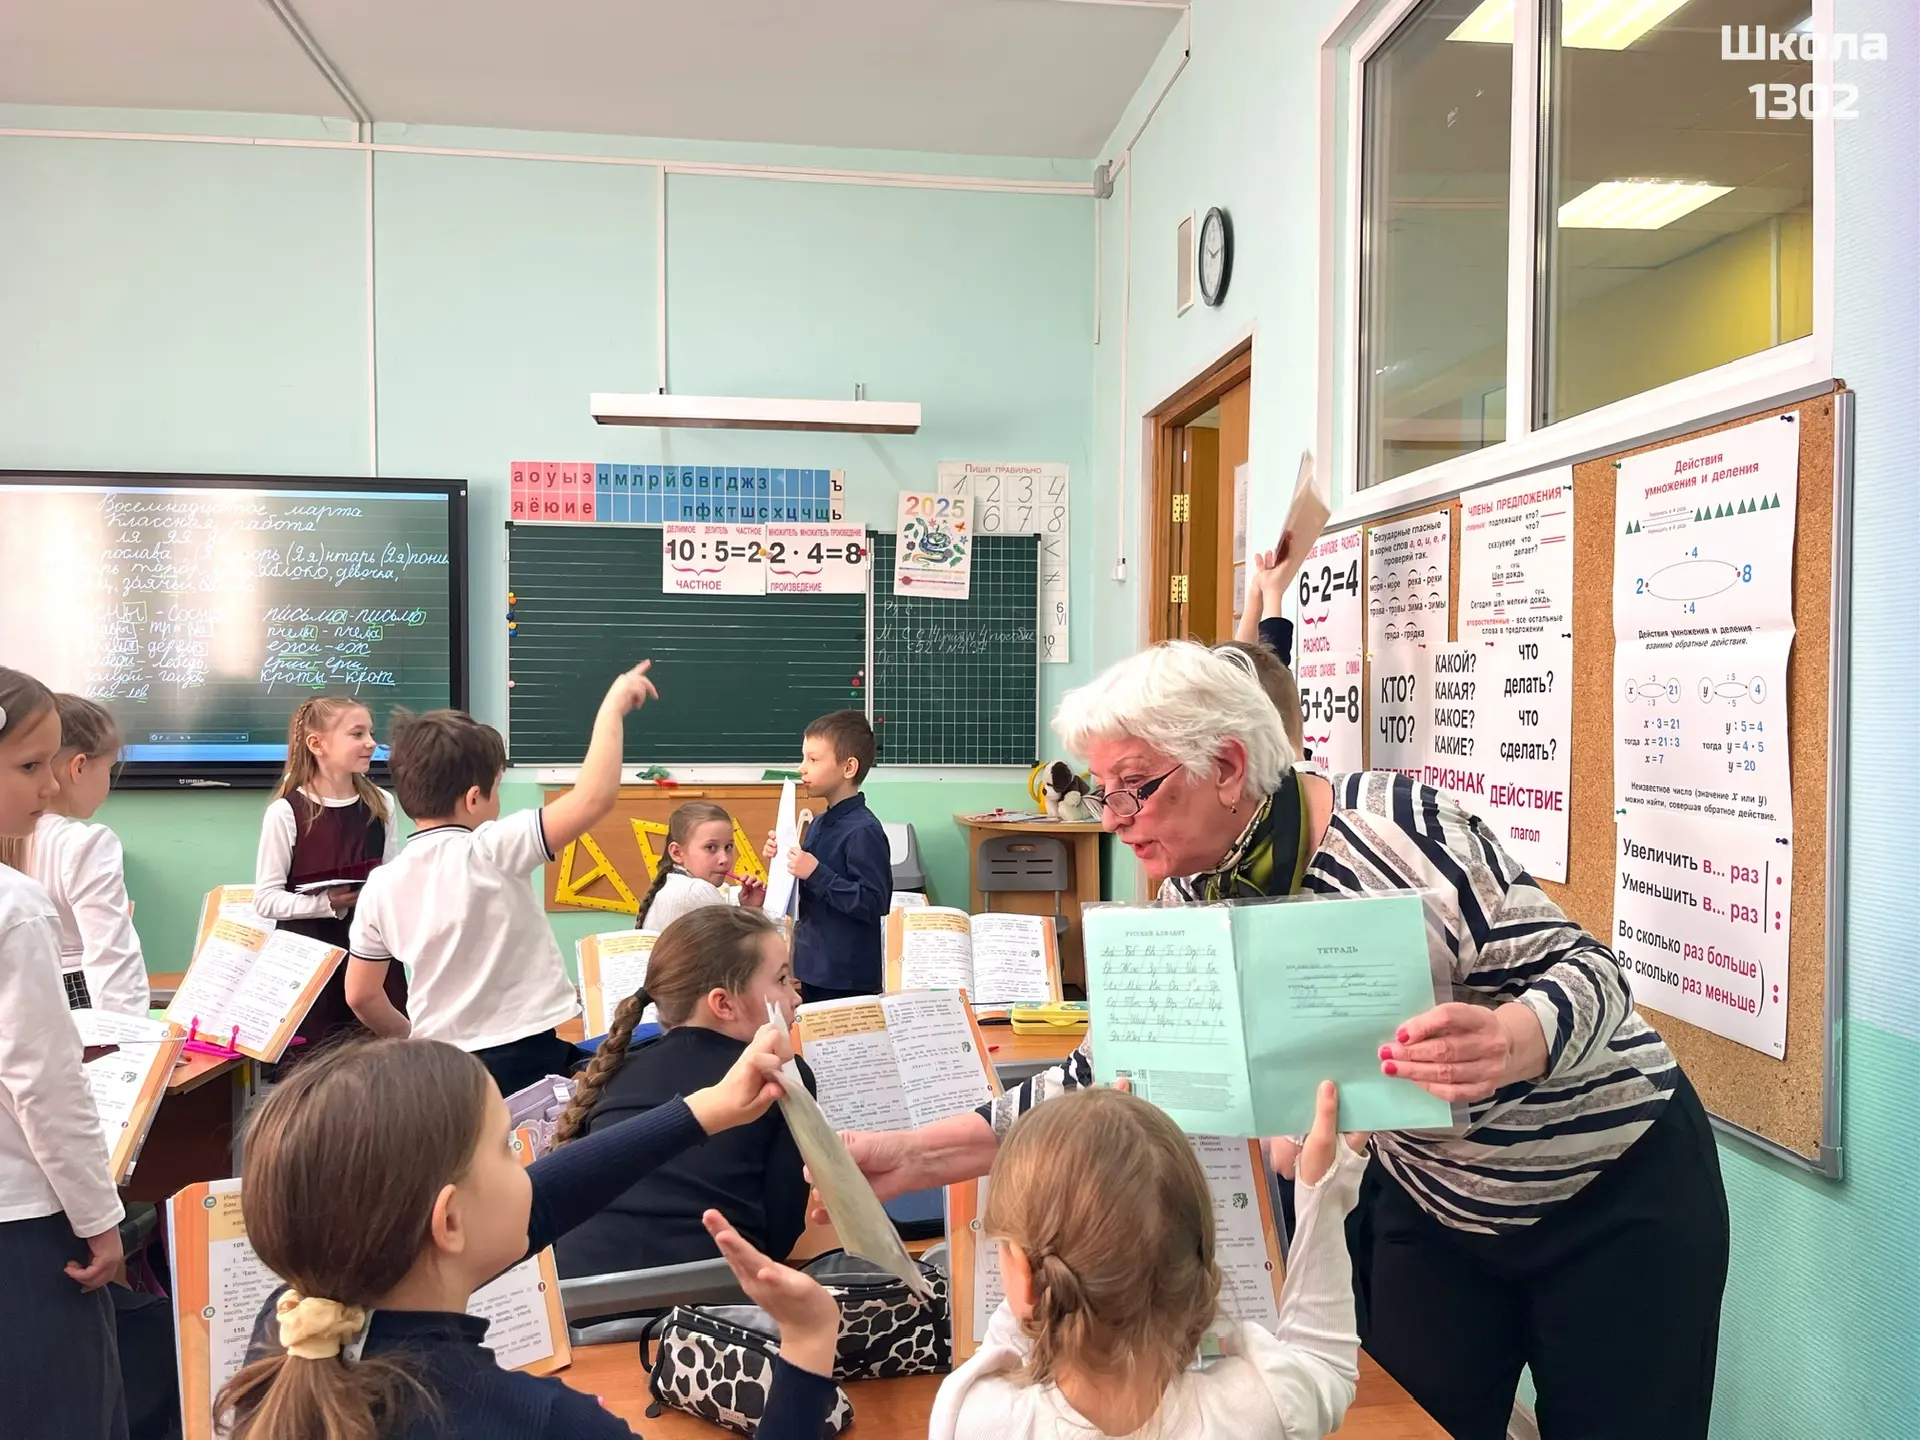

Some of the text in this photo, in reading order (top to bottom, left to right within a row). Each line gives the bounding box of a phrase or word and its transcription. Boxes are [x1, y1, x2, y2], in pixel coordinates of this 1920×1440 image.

[1674, 453, 1723, 475] Действия
[953, 475, 1065, 503] 1 2 3 4
[1645, 462, 1759, 499] умножения и деления
[904, 496, 965, 518] 2025
[1468, 486, 1562, 517] ЧЛЕНЫ ПРЕДЛОЖЕНИЯ
[105, 512, 214, 530] Классная
[285, 504, 363, 523] марта
[983, 506, 1065, 532] 6 7 8
[1525, 509, 1539, 521] кто?
[666, 525, 762, 535] ДЕЛИМОЕ ДЕЛИТЕЛЬ ЧАСТНОЕ
[768, 529, 862, 537] МНОЖИТЕЛЬ МНОЖИТЕЛЬ ПРОИЗВЕДЕНИЕ
[1374, 521, 1441, 542] Безударные гласные
[1525, 521, 1540, 530] что?
[1393, 541, 1408, 553] слов
[1514, 545, 1538, 557] делает?
[1384, 552, 1428, 567] проверяй так.
[1299, 559, 1358, 607] 6-2=4
[1742, 564, 1752, 583] 8
[676, 580, 721, 590] ЧАСТНОЕ
[770, 583, 822, 592] ПРОИЗВЕДЕНИЕ
[1636, 578, 1644, 594] 2
[1056, 602, 1064, 613] 6
[1528, 614, 1563, 624] остальные
[1043, 635, 1055, 646] 10
[1638, 629, 1668, 639] Действия
[1672, 628, 1709, 638] умножения
[1720, 625, 1752, 635] деления
[1303, 636, 1330, 653] РАЗНОСТЬ
[1645, 637, 1748, 650] взаимно обратные действия.
[1435, 650, 1477, 674] КАКОЙ?
[1381, 674, 1416, 704] КТО?
[1435, 682, 1476, 700] КАКАЯ?
[1503, 670, 1554, 698] делать?
[1668, 685, 1678, 695] 21
[1754, 684, 1760, 695] 4
[1434, 708, 1475, 729] КАКОЕ?
[1380, 715, 1415, 744] ЧТО?
[1434, 735, 1474, 757] КАКИЕ?
[1500, 738, 1556, 762] сделать?
[1703, 742, 1722, 751] тогда
[1424, 765, 1485, 795] ПРИЗНАК
[1490, 783, 1563, 811] ДЕЙСТВИЕ
[1631, 781, 1670, 794] Неизвестное
[1673, 787, 1692, 797] число
[1741, 795, 1755, 804] или
[1625, 796, 1644, 805] можно
[1669, 801, 1701, 811] совершая
[1704, 805, 1736, 816] обратное
[1738, 809, 1777, 821] действие.
[1510, 826, 1540, 842] глагол
[1623, 838, 1698, 871] Увеличить
[1730, 864, 1759, 884] раз
[1622, 872, 1697, 907] Уменьшить
[1730, 902, 1758, 924] раз
[1317, 946, 1359, 954] ТЕТРАДЬ
[1619, 919, 1757, 978] Во сколько раз больше
[1618, 950, 1756, 1014] Во сколько раз меньше
